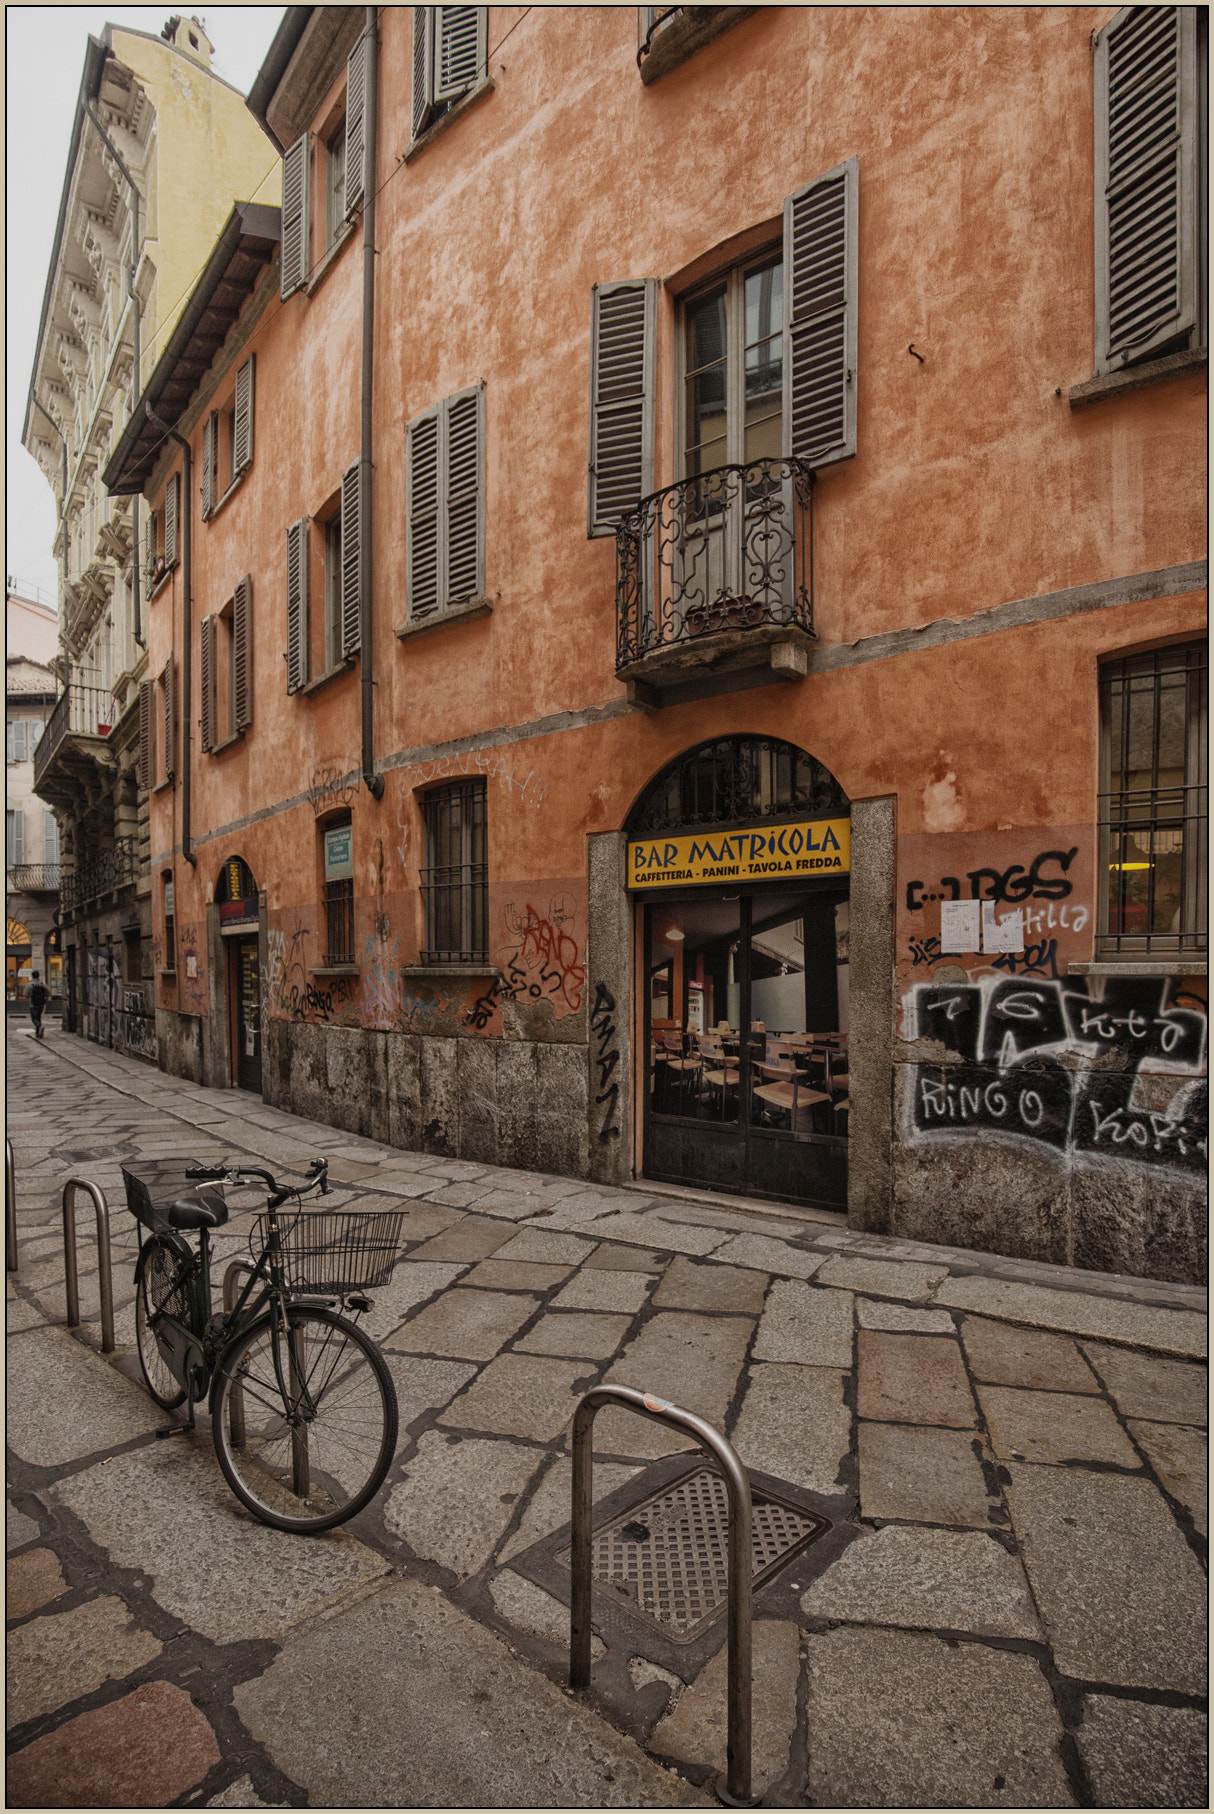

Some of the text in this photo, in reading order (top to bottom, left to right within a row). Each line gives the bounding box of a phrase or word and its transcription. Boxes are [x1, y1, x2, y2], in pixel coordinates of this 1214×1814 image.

[634, 843, 678, 869] BAR
[635, 856, 842, 883] CAFFETTERIA PANINI TAVOLA FREDDA
